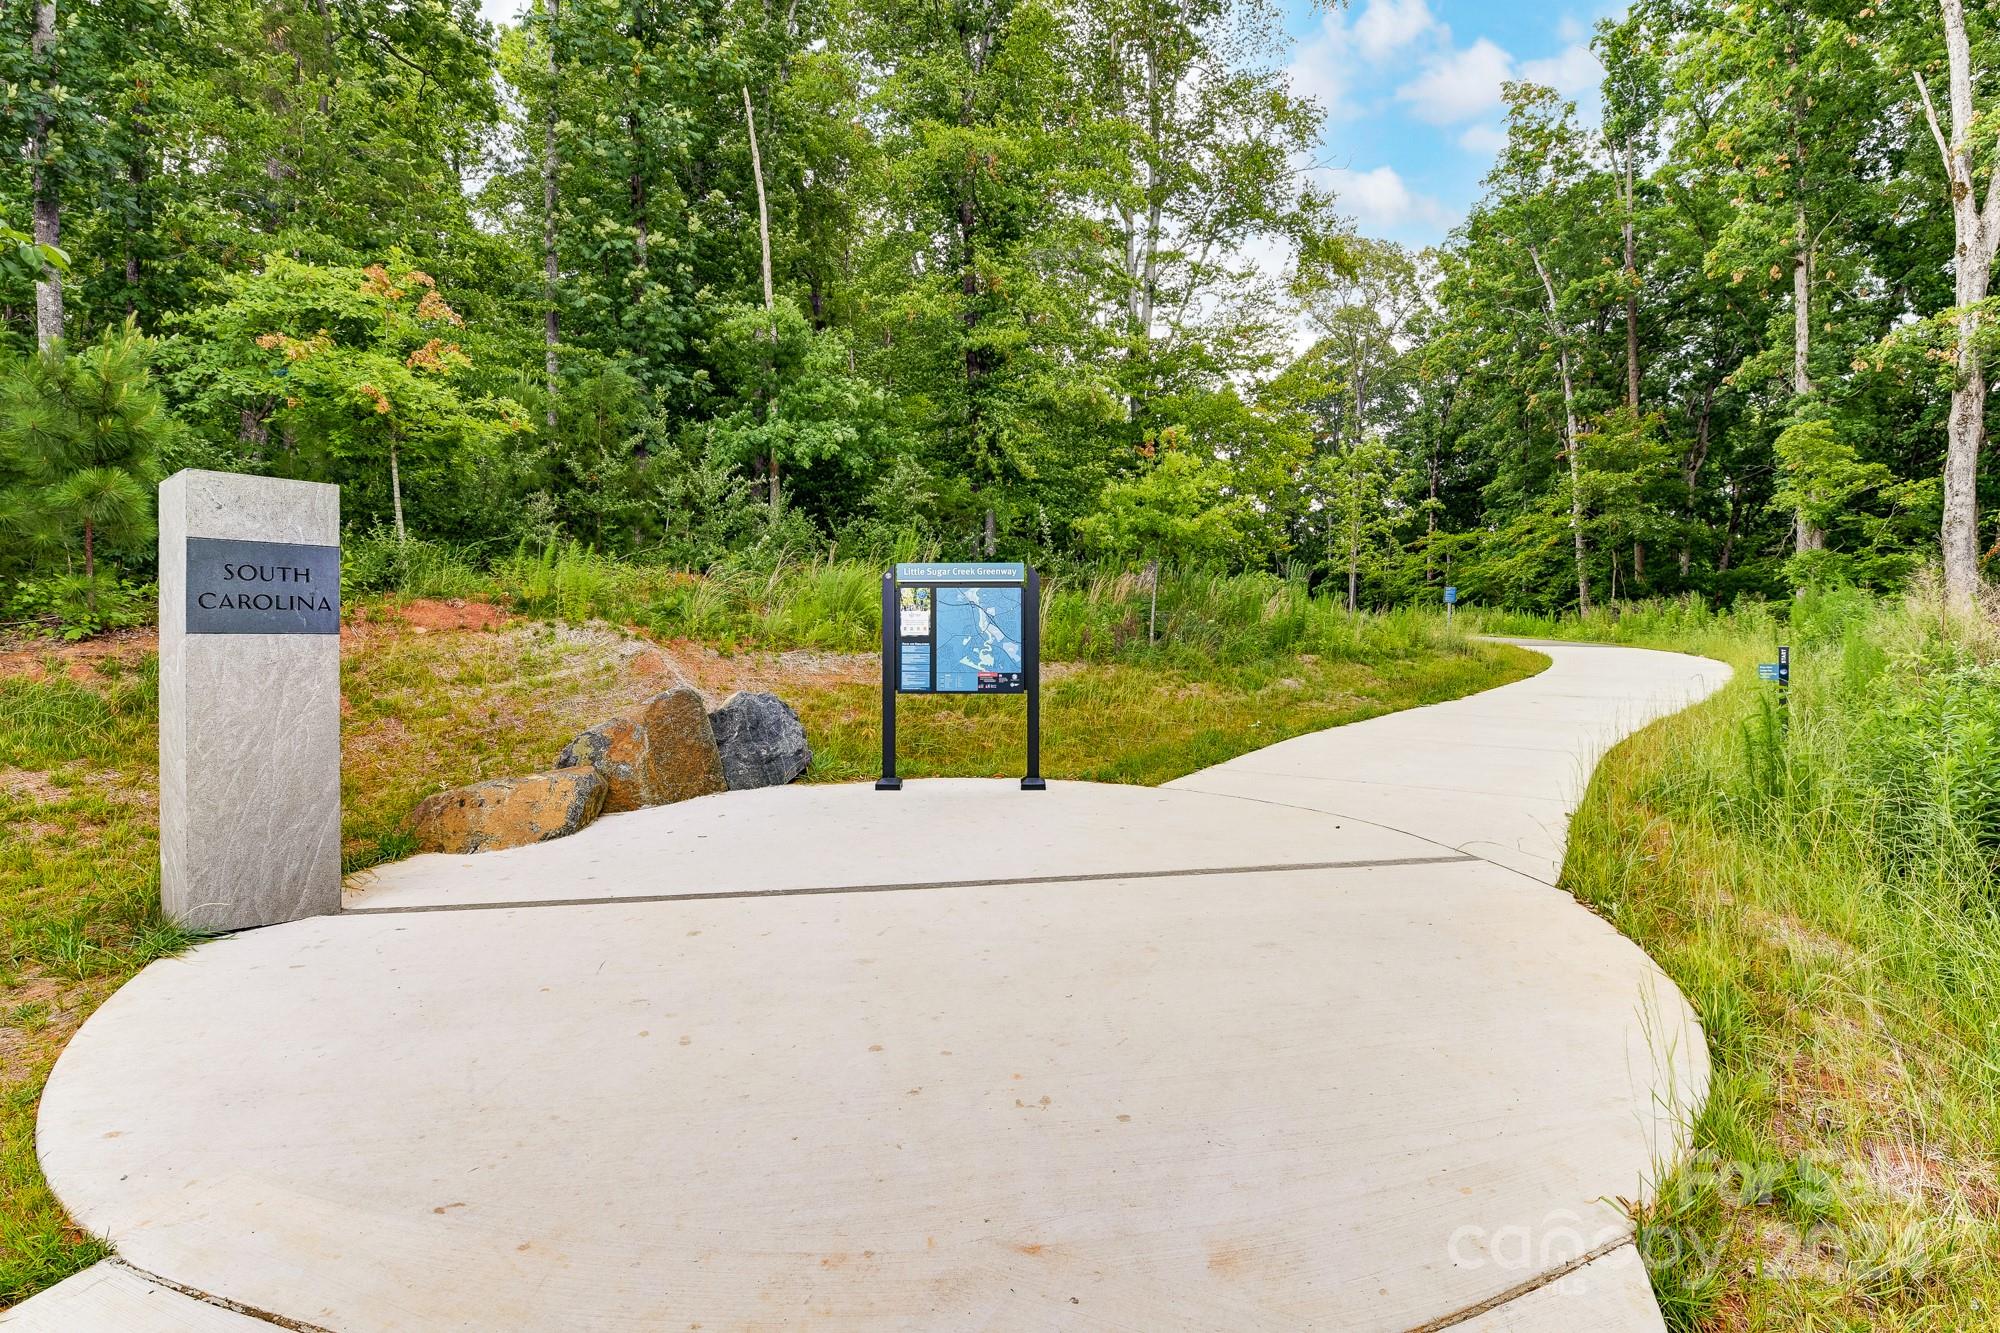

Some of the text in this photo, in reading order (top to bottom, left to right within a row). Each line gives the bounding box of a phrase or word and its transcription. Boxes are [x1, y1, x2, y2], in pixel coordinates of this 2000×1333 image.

[223, 563, 311, 583] SOUTH
[903, 567, 1017, 577] Little Sugar Creek Greenway
[197, 592, 332, 612] CAROLINA
